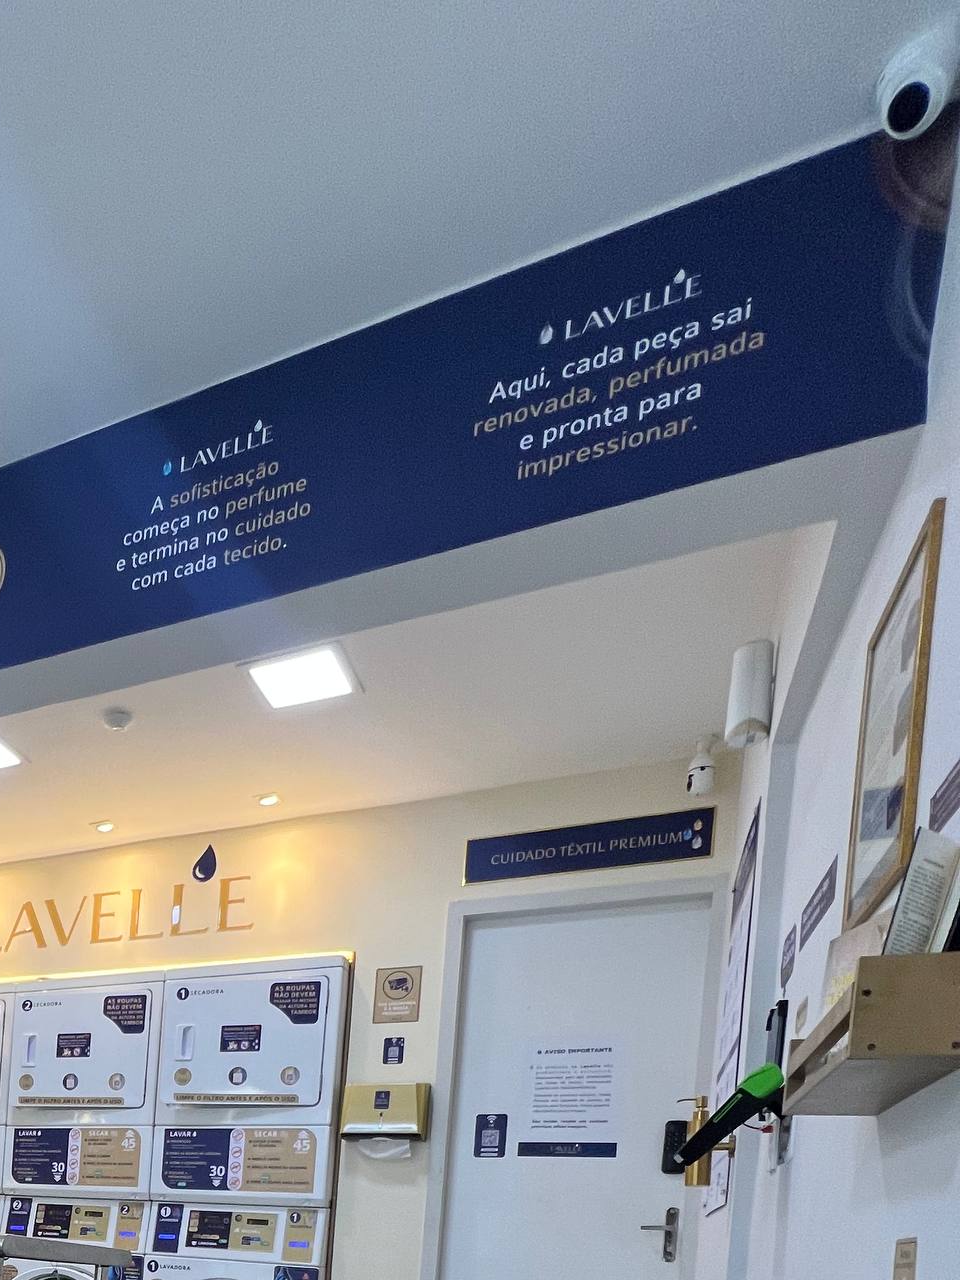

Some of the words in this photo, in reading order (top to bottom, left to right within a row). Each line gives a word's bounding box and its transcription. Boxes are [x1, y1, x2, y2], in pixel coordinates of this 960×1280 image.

[564, 273, 703, 341] LAVELLE
[488, 366, 551, 405] Aqui,
[561, 342, 625, 379] cada
[633, 320, 700, 360] peça
[711, 297, 754, 333] sai
[472, 387, 597, 438] renovada,
[607, 329, 767, 401] perfumada
[519, 433, 534, 451] e
[541, 403, 629, 449] pronta
[637, 381, 702, 422] para
[180, 425, 274, 473] LAVELLE
[515, 413, 698, 481] impressionar.
[123, 515, 191, 547] começa
[196, 506, 220, 524] no
[225, 478, 307, 520] perfume
[150, 495, 165, 515] A
[169, 461, 280, 509] sofisticação
[116, 559, 126, 572] e
[131, 536, 200, 569] termina
[205, 527, 229, 546] no
[234, 500, 312, 537] cuidado
[131, 569, 168, 591] com
[174, 554, 217, 579] cada
[223, 535, 288, 565] tecido.
[490, 847, 557, 866] CUIDADO
[560, 837, 606, 858] TÊXTIL
[609, 830, 683, 851] PREMIUM
[190, 988, 224, 997] SECADORA
[51, 1162, 65, 1172] 30
[121, 1138, 136, 1149] 45
[208, 1165, 226, 1177] 30
[293, 1140, 311, 1152] 45
